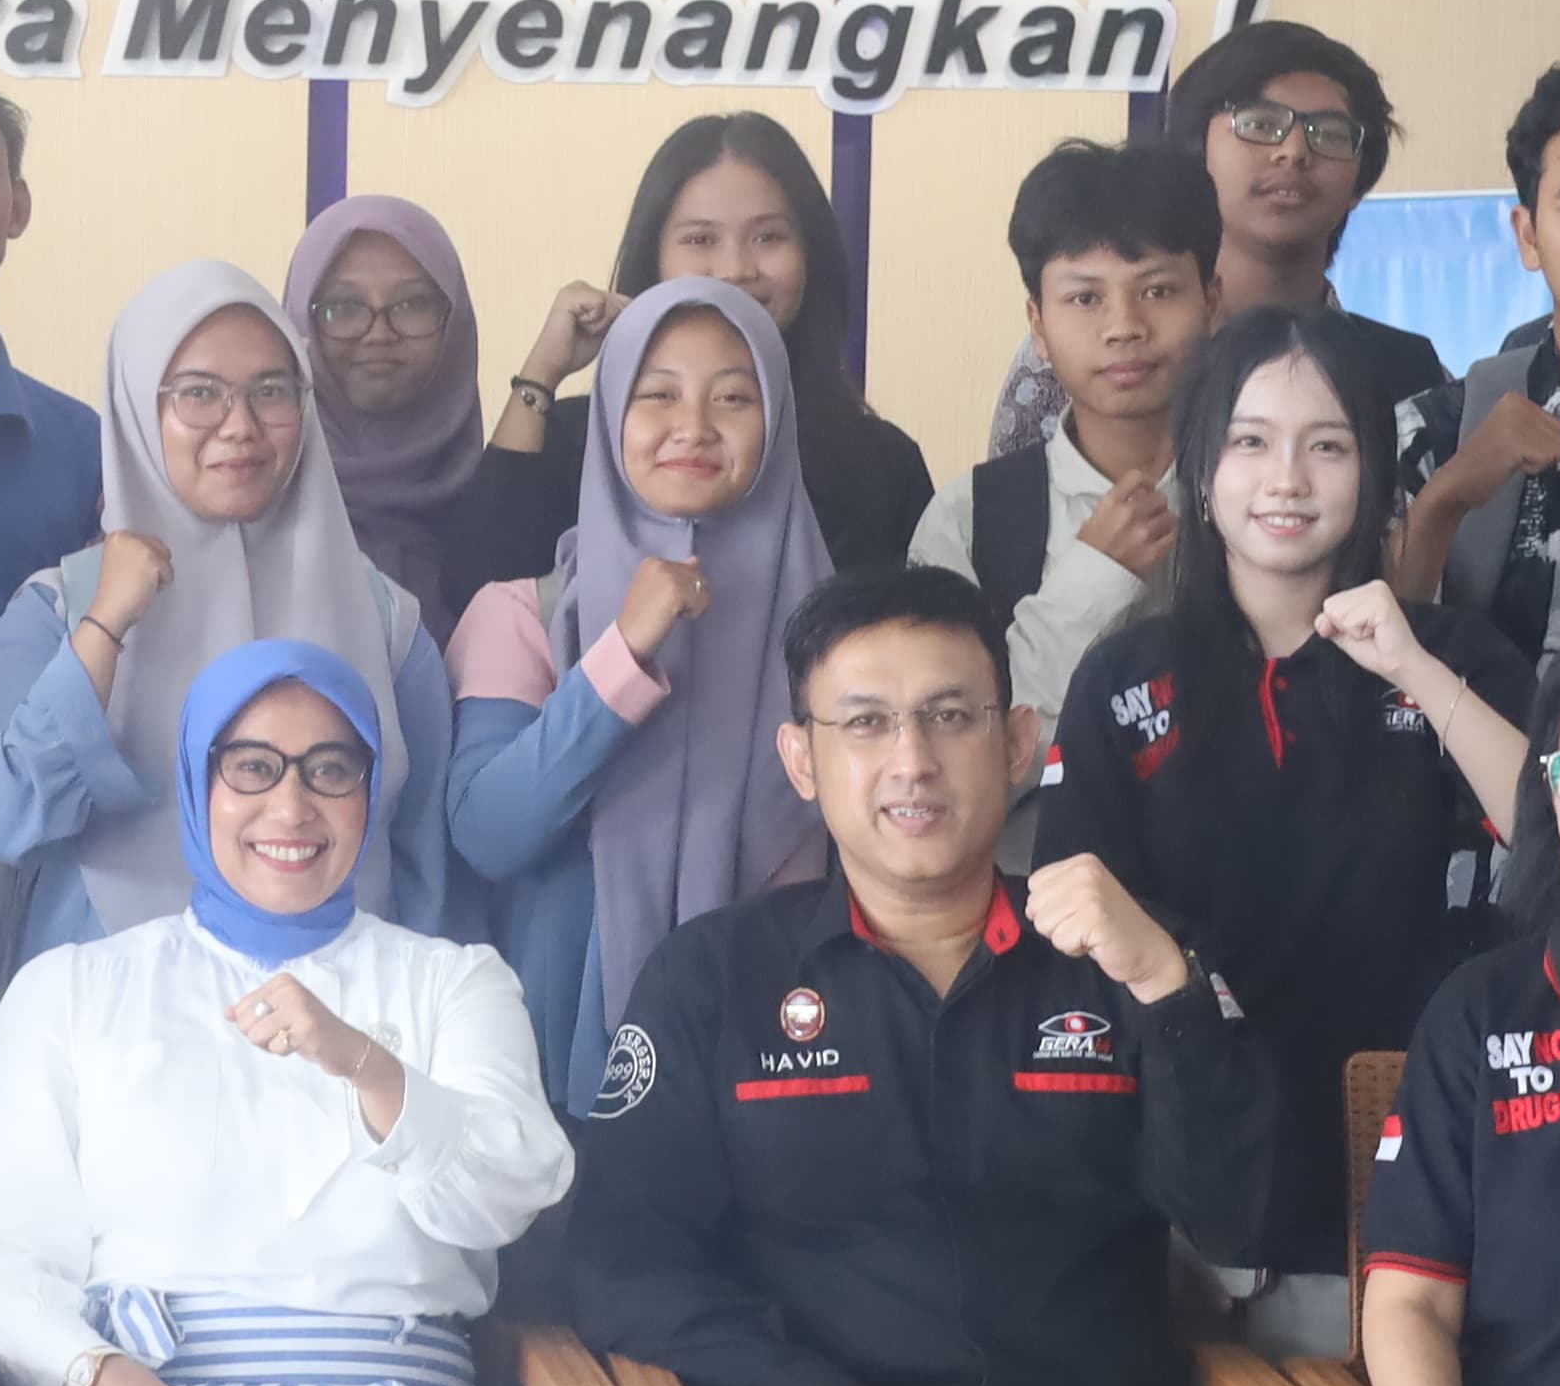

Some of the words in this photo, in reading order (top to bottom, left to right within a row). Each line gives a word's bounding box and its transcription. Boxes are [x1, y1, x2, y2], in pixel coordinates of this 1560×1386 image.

[1110, 680, 1154, 727] SAY
[1137, 709, 1172, 744] TO
[760, 1048, 840, 1074] HAVID
[1486, 1030, 1534, 1071] SAY
[1509, 1065, 1554, 1097] TO
